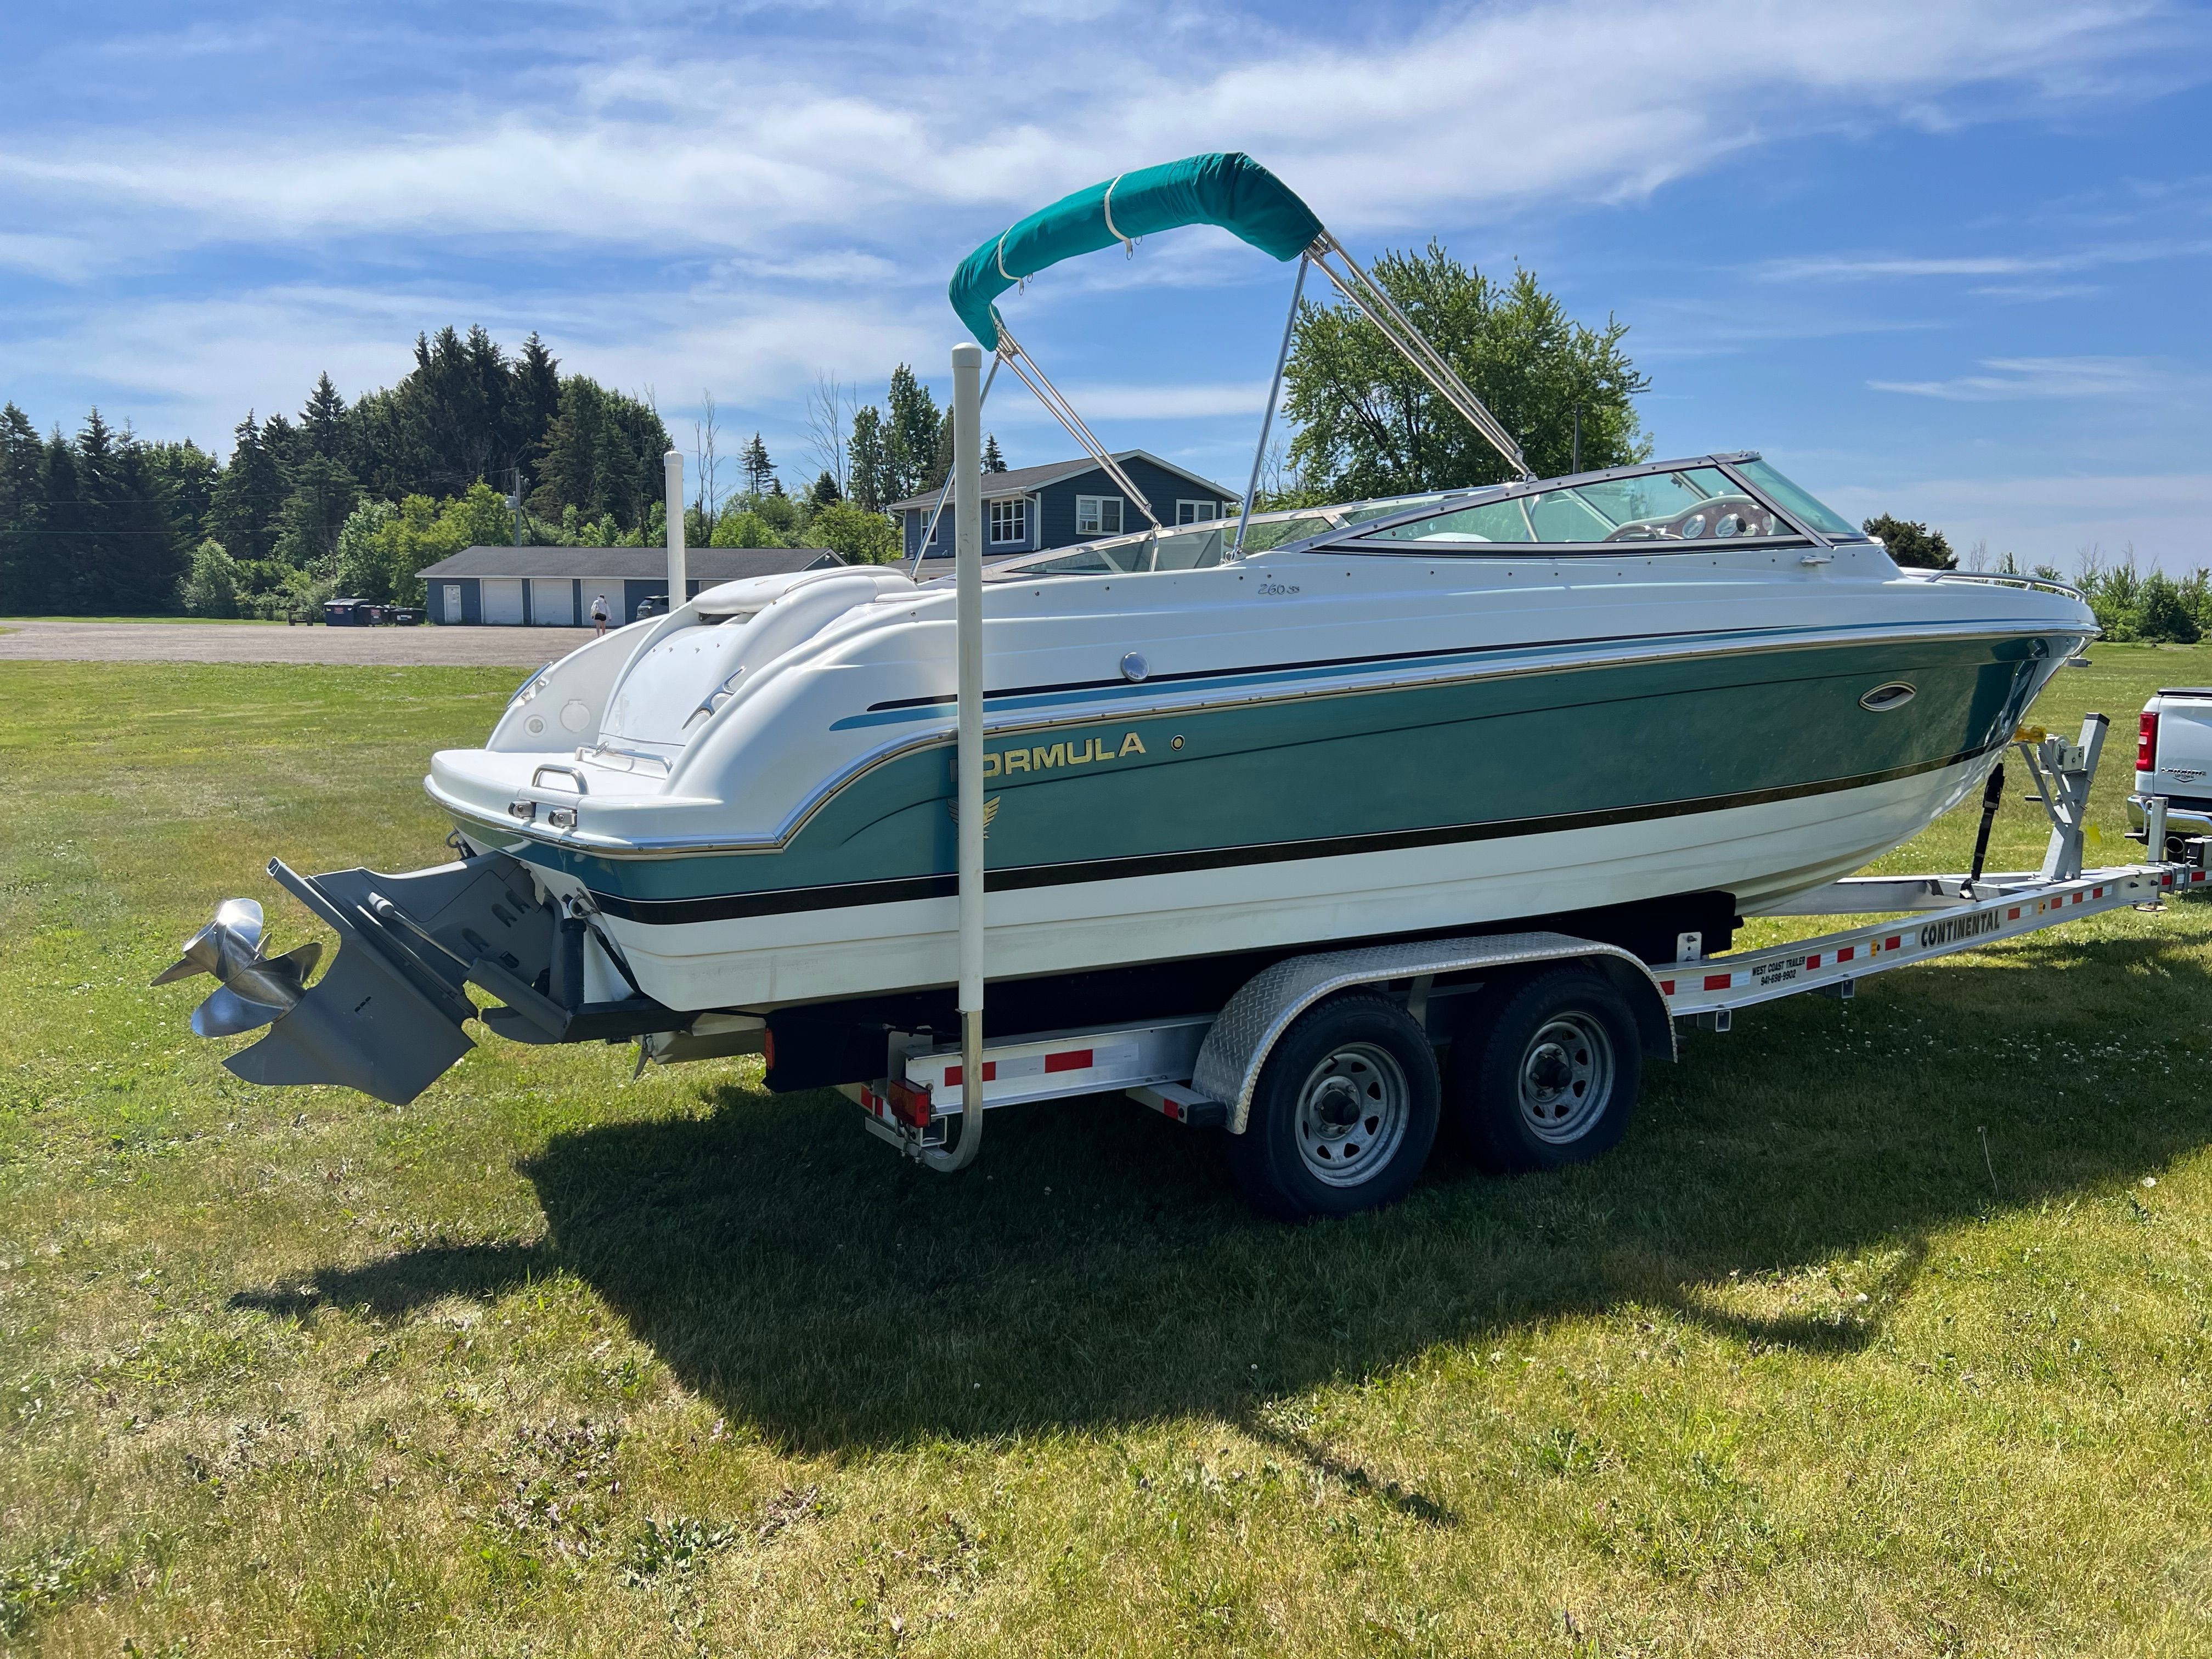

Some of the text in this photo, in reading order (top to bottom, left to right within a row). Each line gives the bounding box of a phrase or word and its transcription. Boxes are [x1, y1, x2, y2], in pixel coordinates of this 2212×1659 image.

[1258, 584, 1285, 595] 260
[1921, 909, 2000, 949] CONTINENTAL
[1752, 956, 1805, 976] WEST COAST TRAILER
